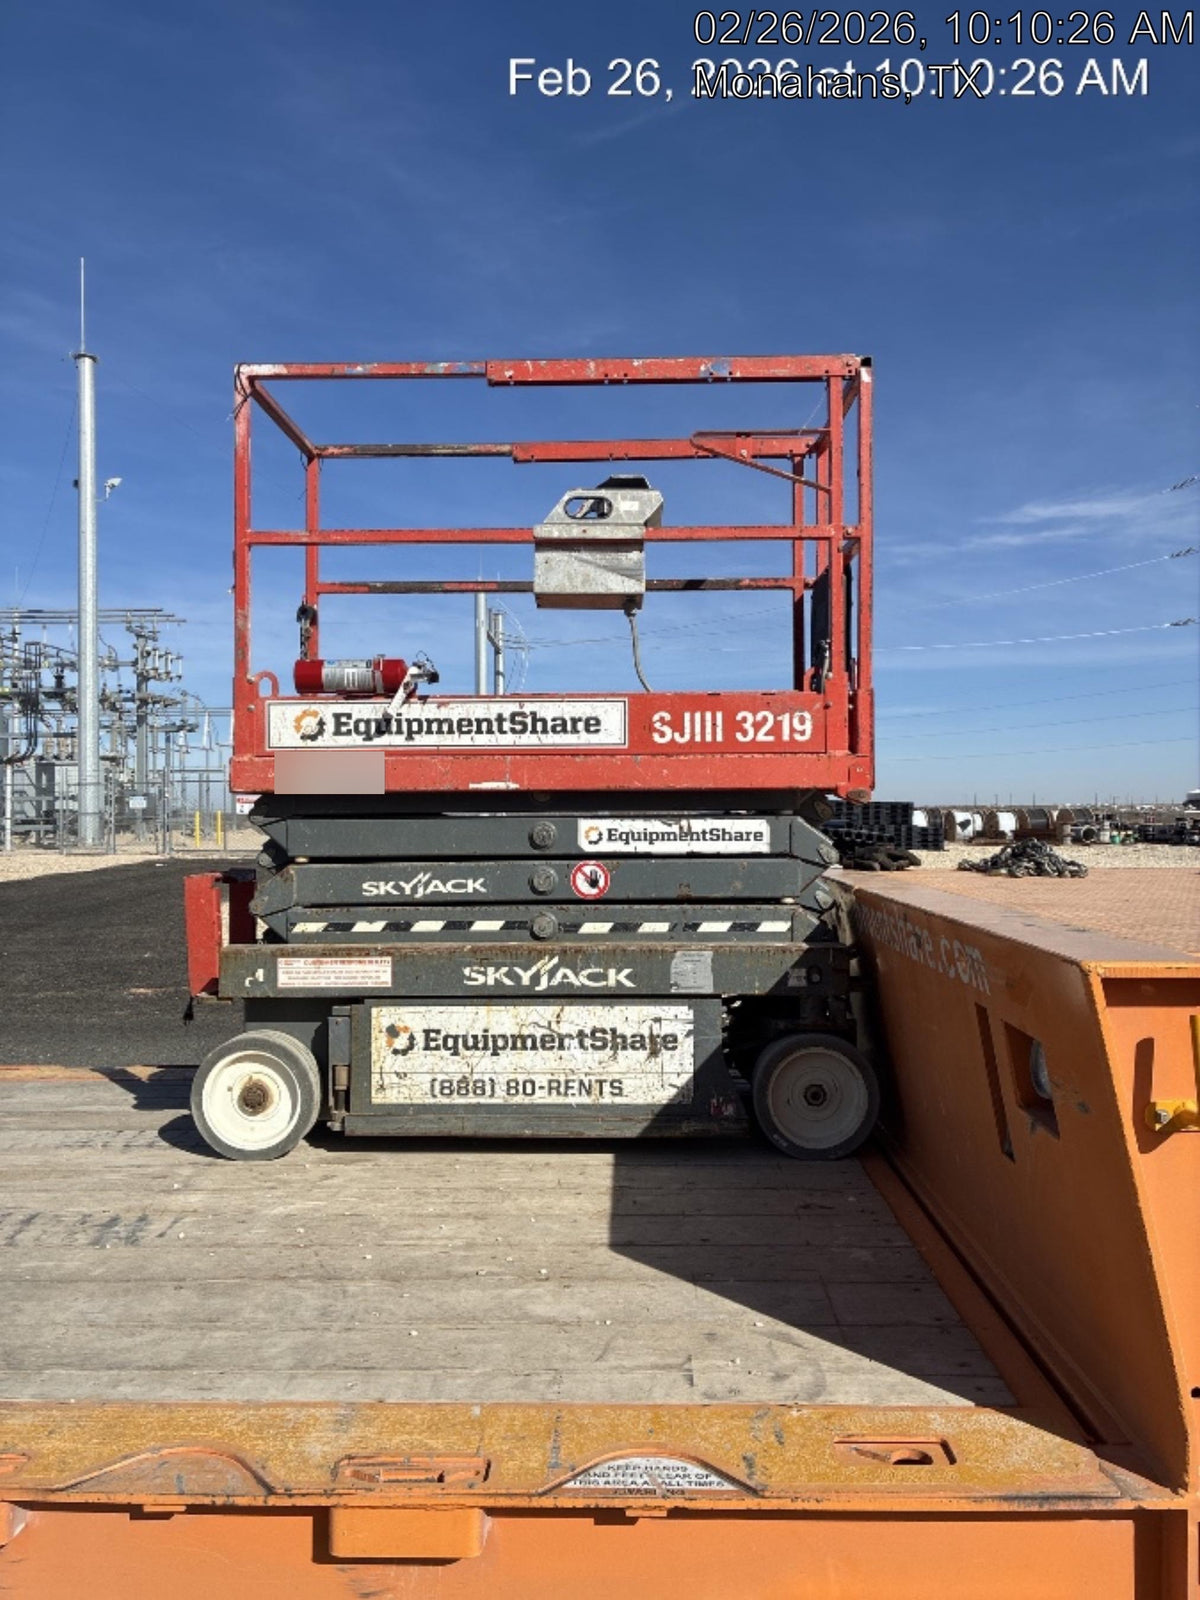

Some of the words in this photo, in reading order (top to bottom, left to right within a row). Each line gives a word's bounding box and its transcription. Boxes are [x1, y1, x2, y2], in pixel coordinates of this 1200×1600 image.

[332, 709, 602, 738] EquipmentShare
[735, 710, 813, 743] 3219
[606, 825, 764, 847] EquipmentShare
[361, 871, 488, 900] SKYJACK
[463, 955, 636, 992] SKYJACK
[430, 1077, 496, 1098] (888)
[505, 1077, 624, 1098] 80-RENTS
[583, 1472, 611, 1480] AND
[656, 1472, 693, 1480] LEAR
[695, 1472, 714, 1480] OF
[607, 1464, 642, 1472] KEEP
[644, 1464, 689, 1472] HANDS
[573, 1479, 601, 1487] THIS
[603, 1479, 639, 1487] AREA
[687, 1479, 726, 1488] TIMES
